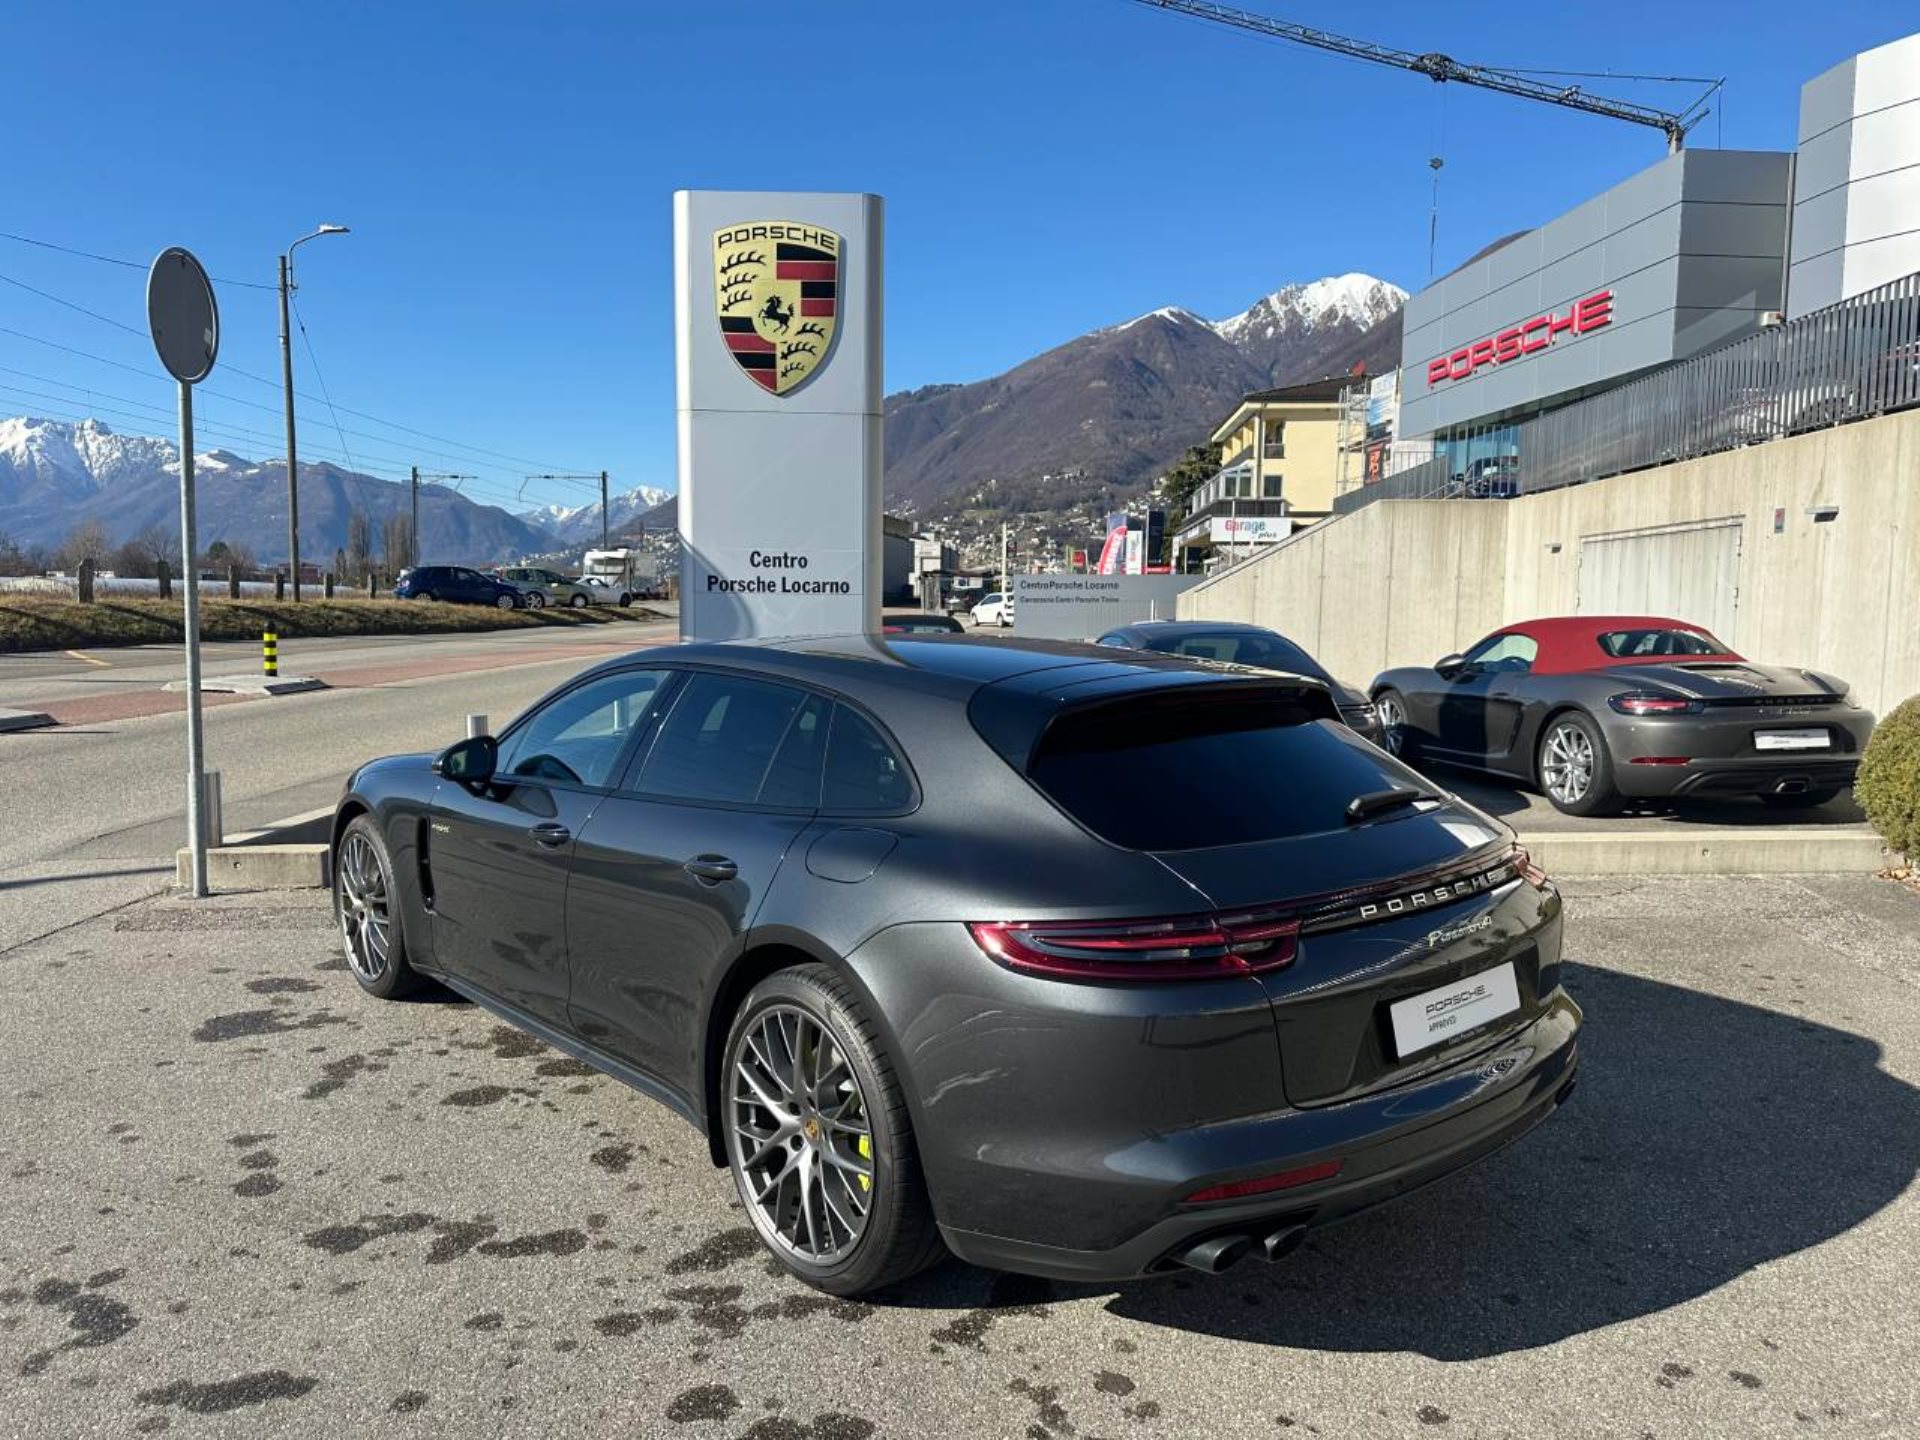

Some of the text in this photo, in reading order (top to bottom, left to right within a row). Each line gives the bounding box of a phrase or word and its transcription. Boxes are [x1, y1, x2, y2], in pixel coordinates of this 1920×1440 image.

[718, 225, 835, 251] PORSCHE
[1428, 289, 1615, 387] PORSCHE
[1225, 520, 1265, 534] Garage
[749, 550, 808, 569] Centro
[707, 575, 850, 594] Porsche Locarno
[1085, 580, 1119, 590] Locarno
[1360, 871, 1498, 918] PORSCHE
[1425, 984, 1486, 1014] PORSCHE
